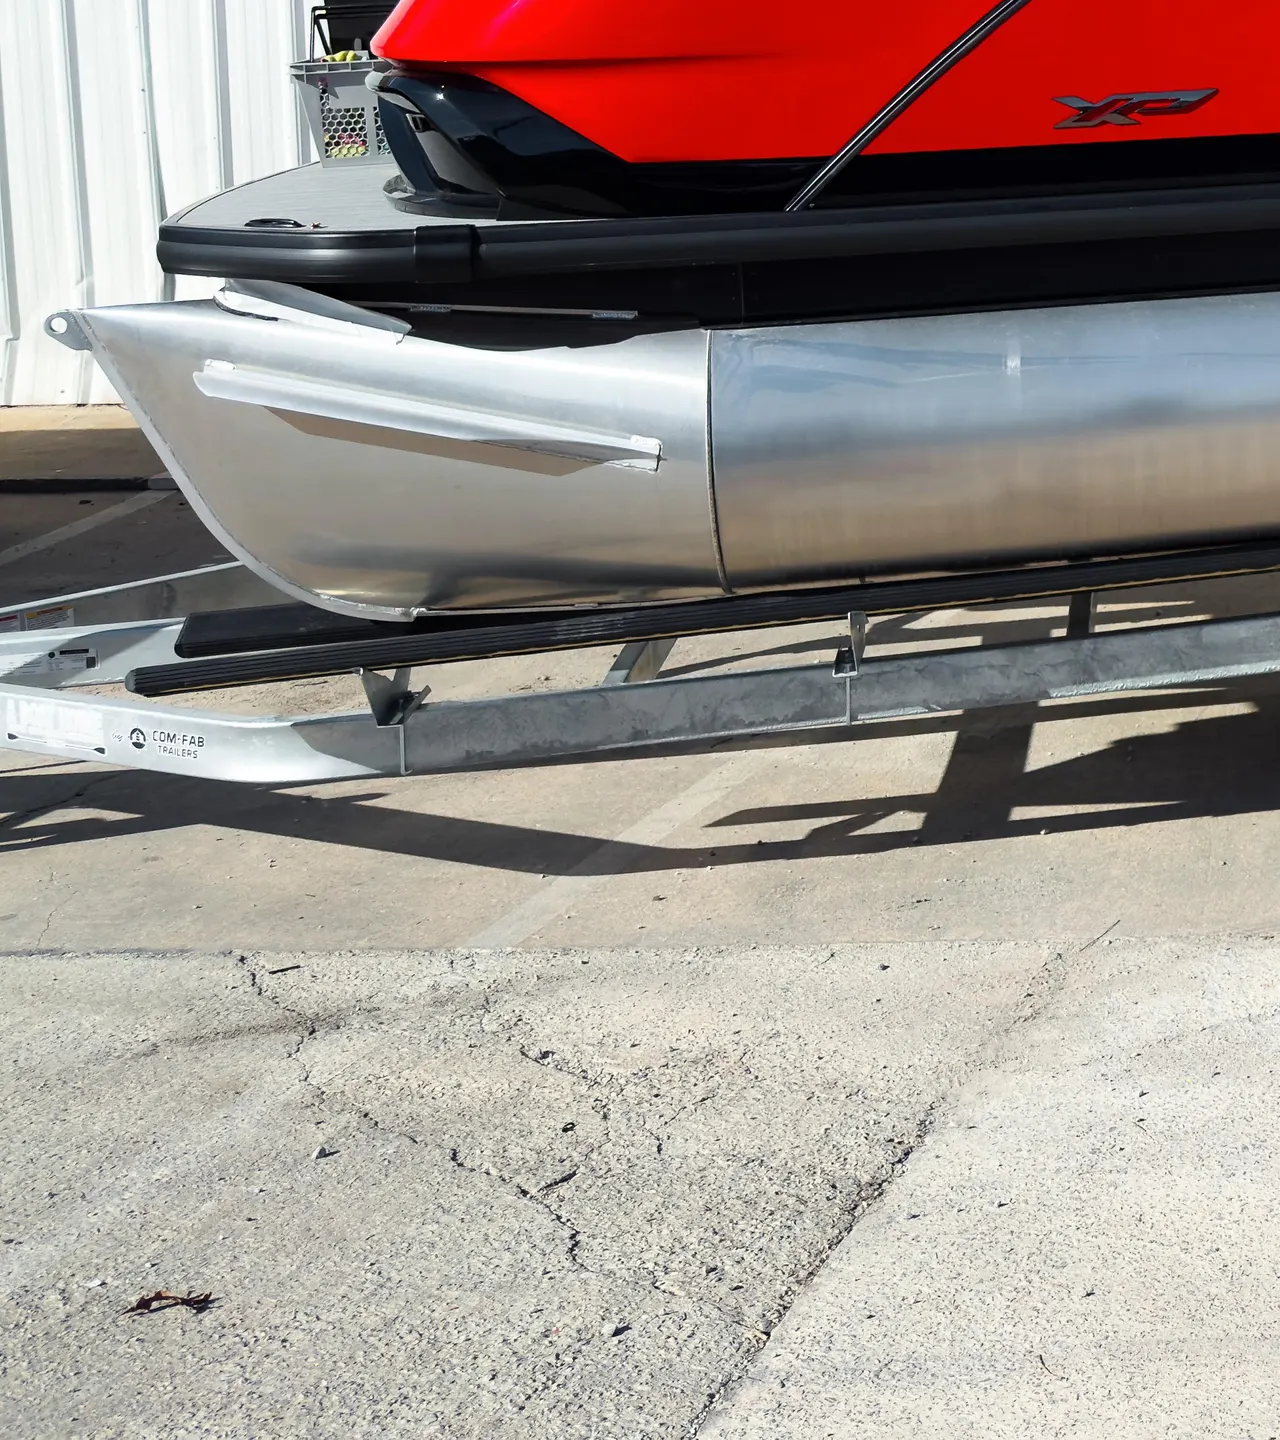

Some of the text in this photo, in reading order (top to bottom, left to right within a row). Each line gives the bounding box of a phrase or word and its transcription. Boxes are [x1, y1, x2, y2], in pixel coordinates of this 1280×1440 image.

[1051, 88, 1219, 129] XP
[152, 730, 205, 748] COM-FAB
[158, 744, 198, 759] TRAILERS
